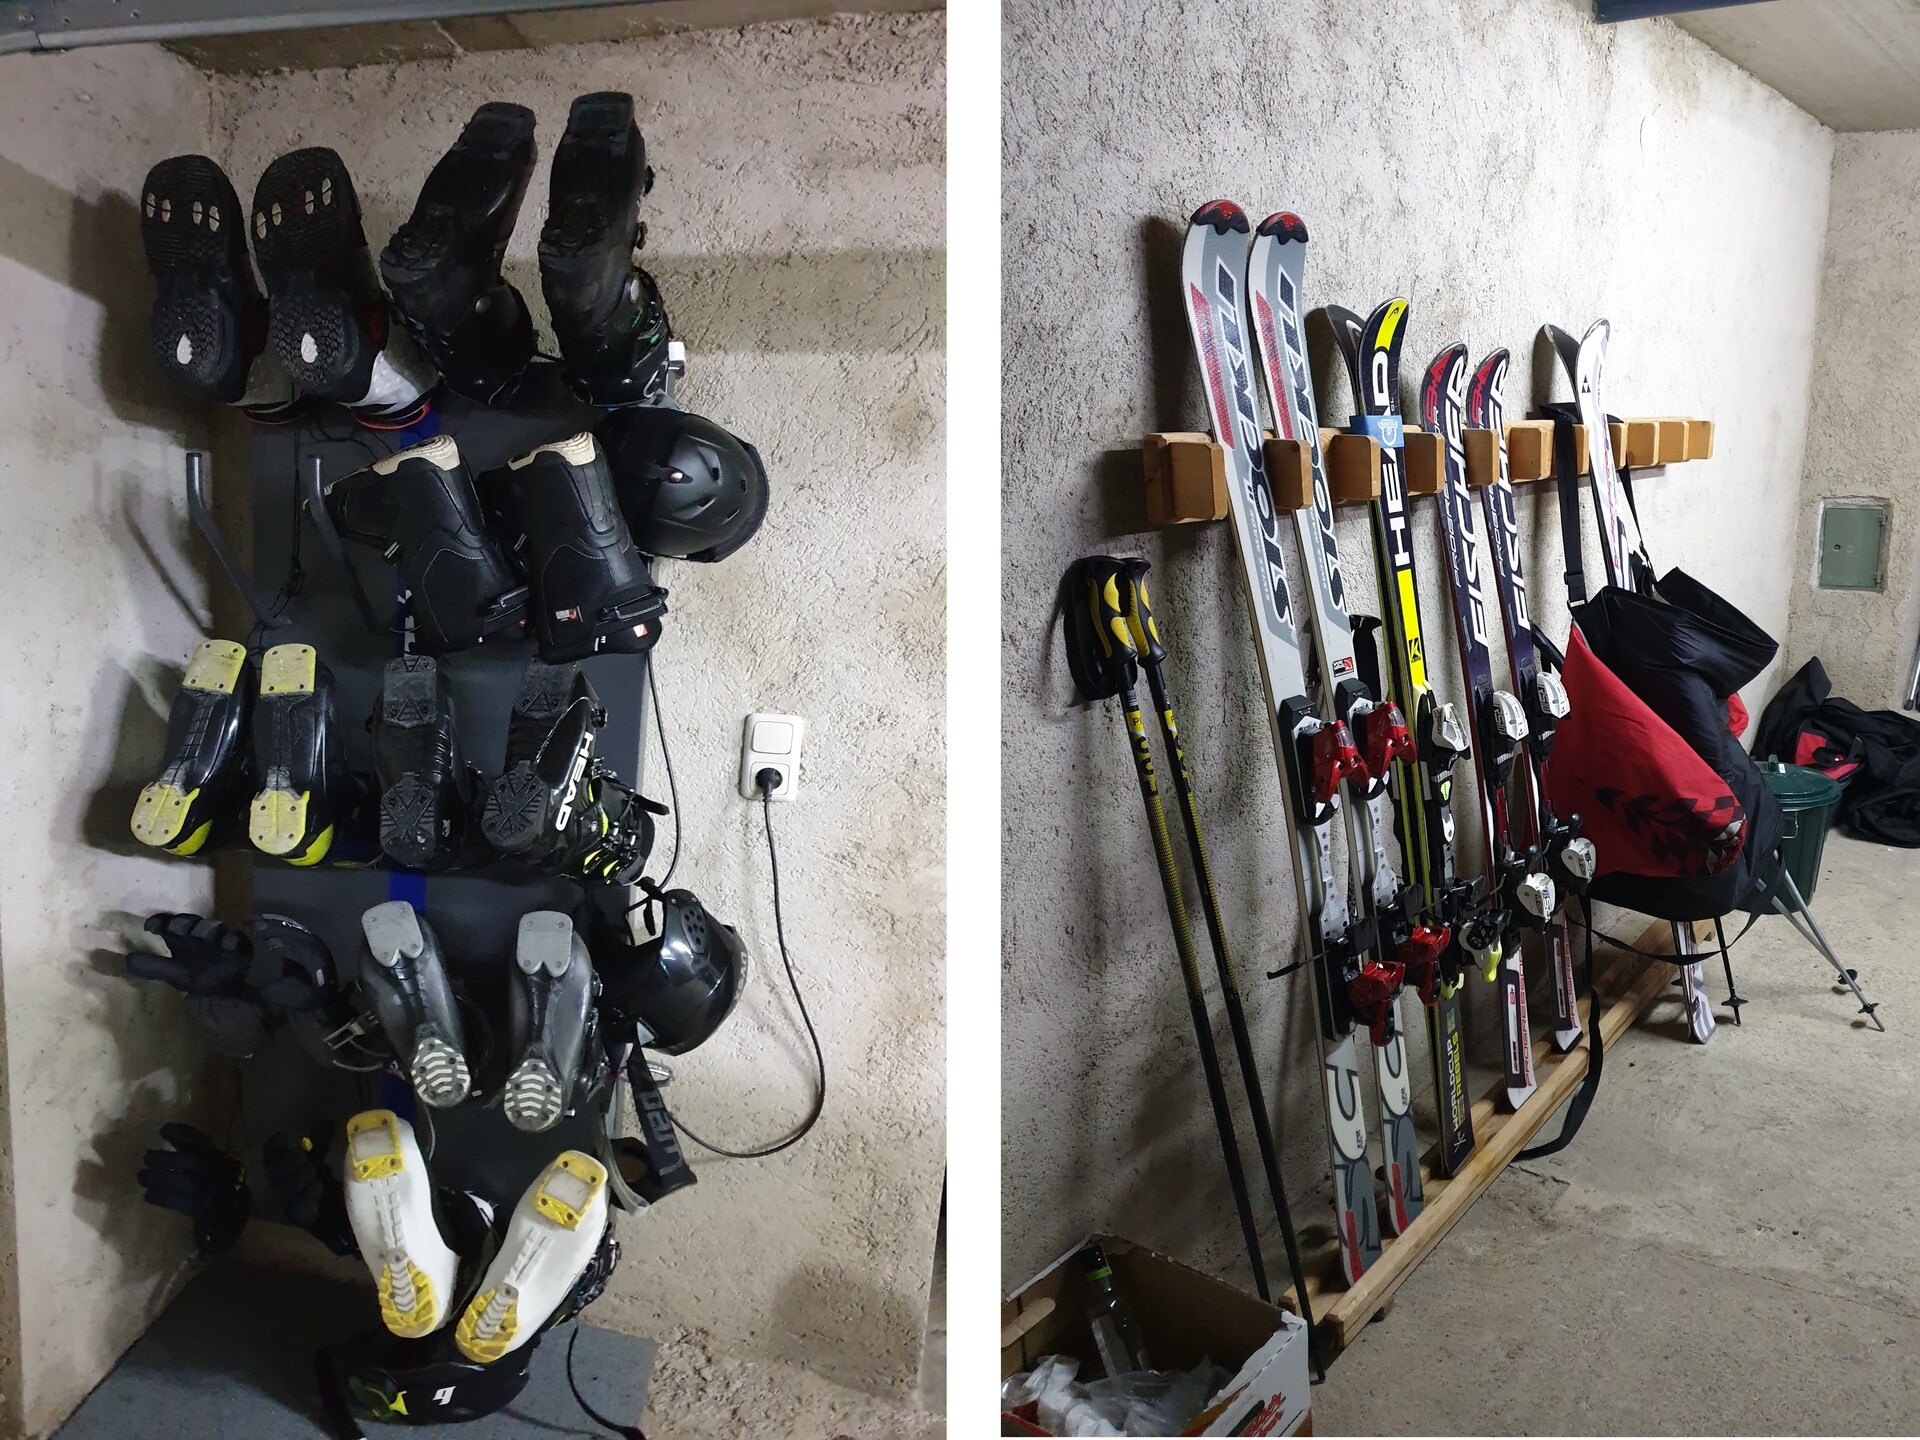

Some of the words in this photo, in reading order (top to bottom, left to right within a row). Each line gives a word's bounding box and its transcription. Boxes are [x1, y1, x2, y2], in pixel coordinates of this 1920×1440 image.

[1215, 254, 1296, 630] STÖCKLI
[1250, 507, 1262, 552] MADE
[1309, 507, 1320, 544] MAD
[1445, 354, 1488, 647] FISCHER
[1259, 557, 1271, 602] SWISS
[555, 733, 593, 831] HEAD
[1446, 1038, 1459, 1132] WORLDCUP
